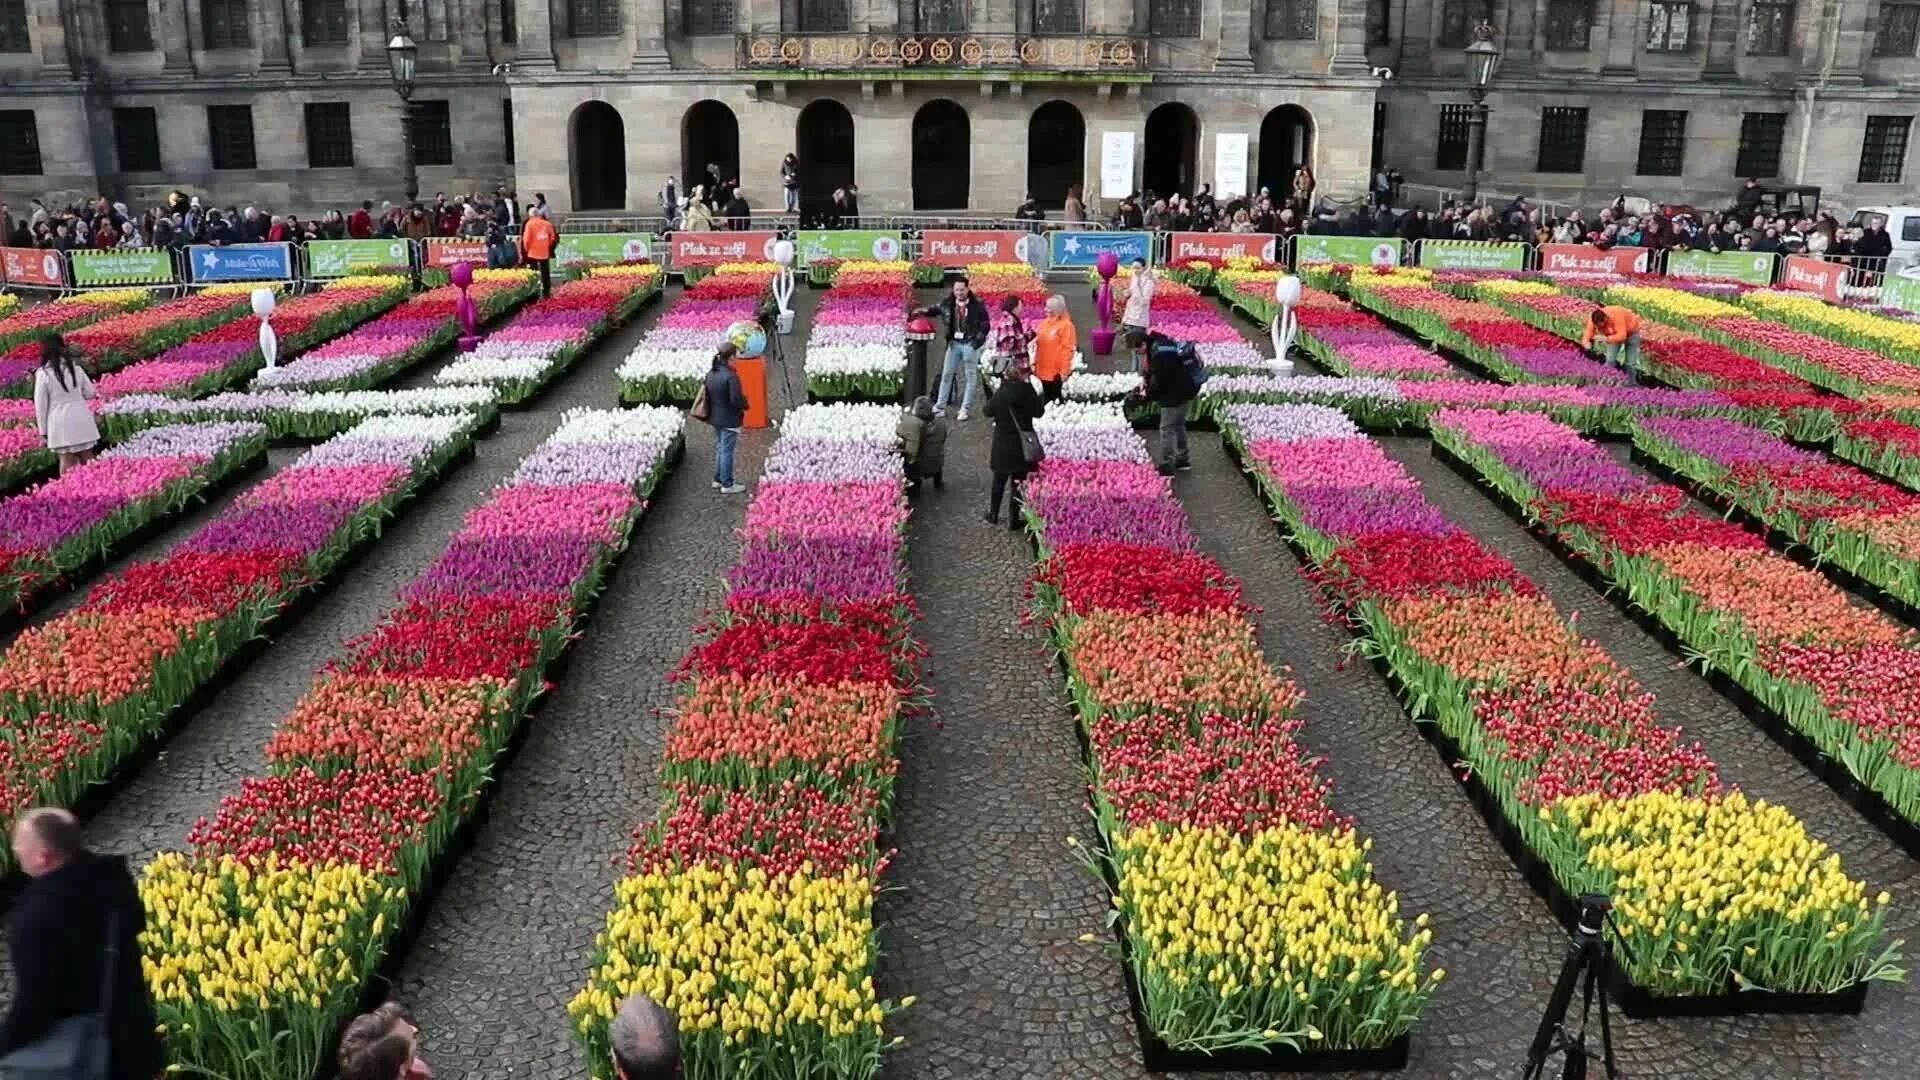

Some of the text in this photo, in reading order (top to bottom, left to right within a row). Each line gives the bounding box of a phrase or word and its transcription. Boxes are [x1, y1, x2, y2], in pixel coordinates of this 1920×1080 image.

[680, 241, 708, 257] Pluk
[709, 246, 721, 256] ze
[931, 241, 958, 256] Pluk
[960, 245, 972, 255] ze
[1179, 242, 1207, 257] Pluk
[1208, 247, 1220, 257] ze
[1551, 253, 1578, 269] Pluk
[1579, 259, 1592, 268] ze
